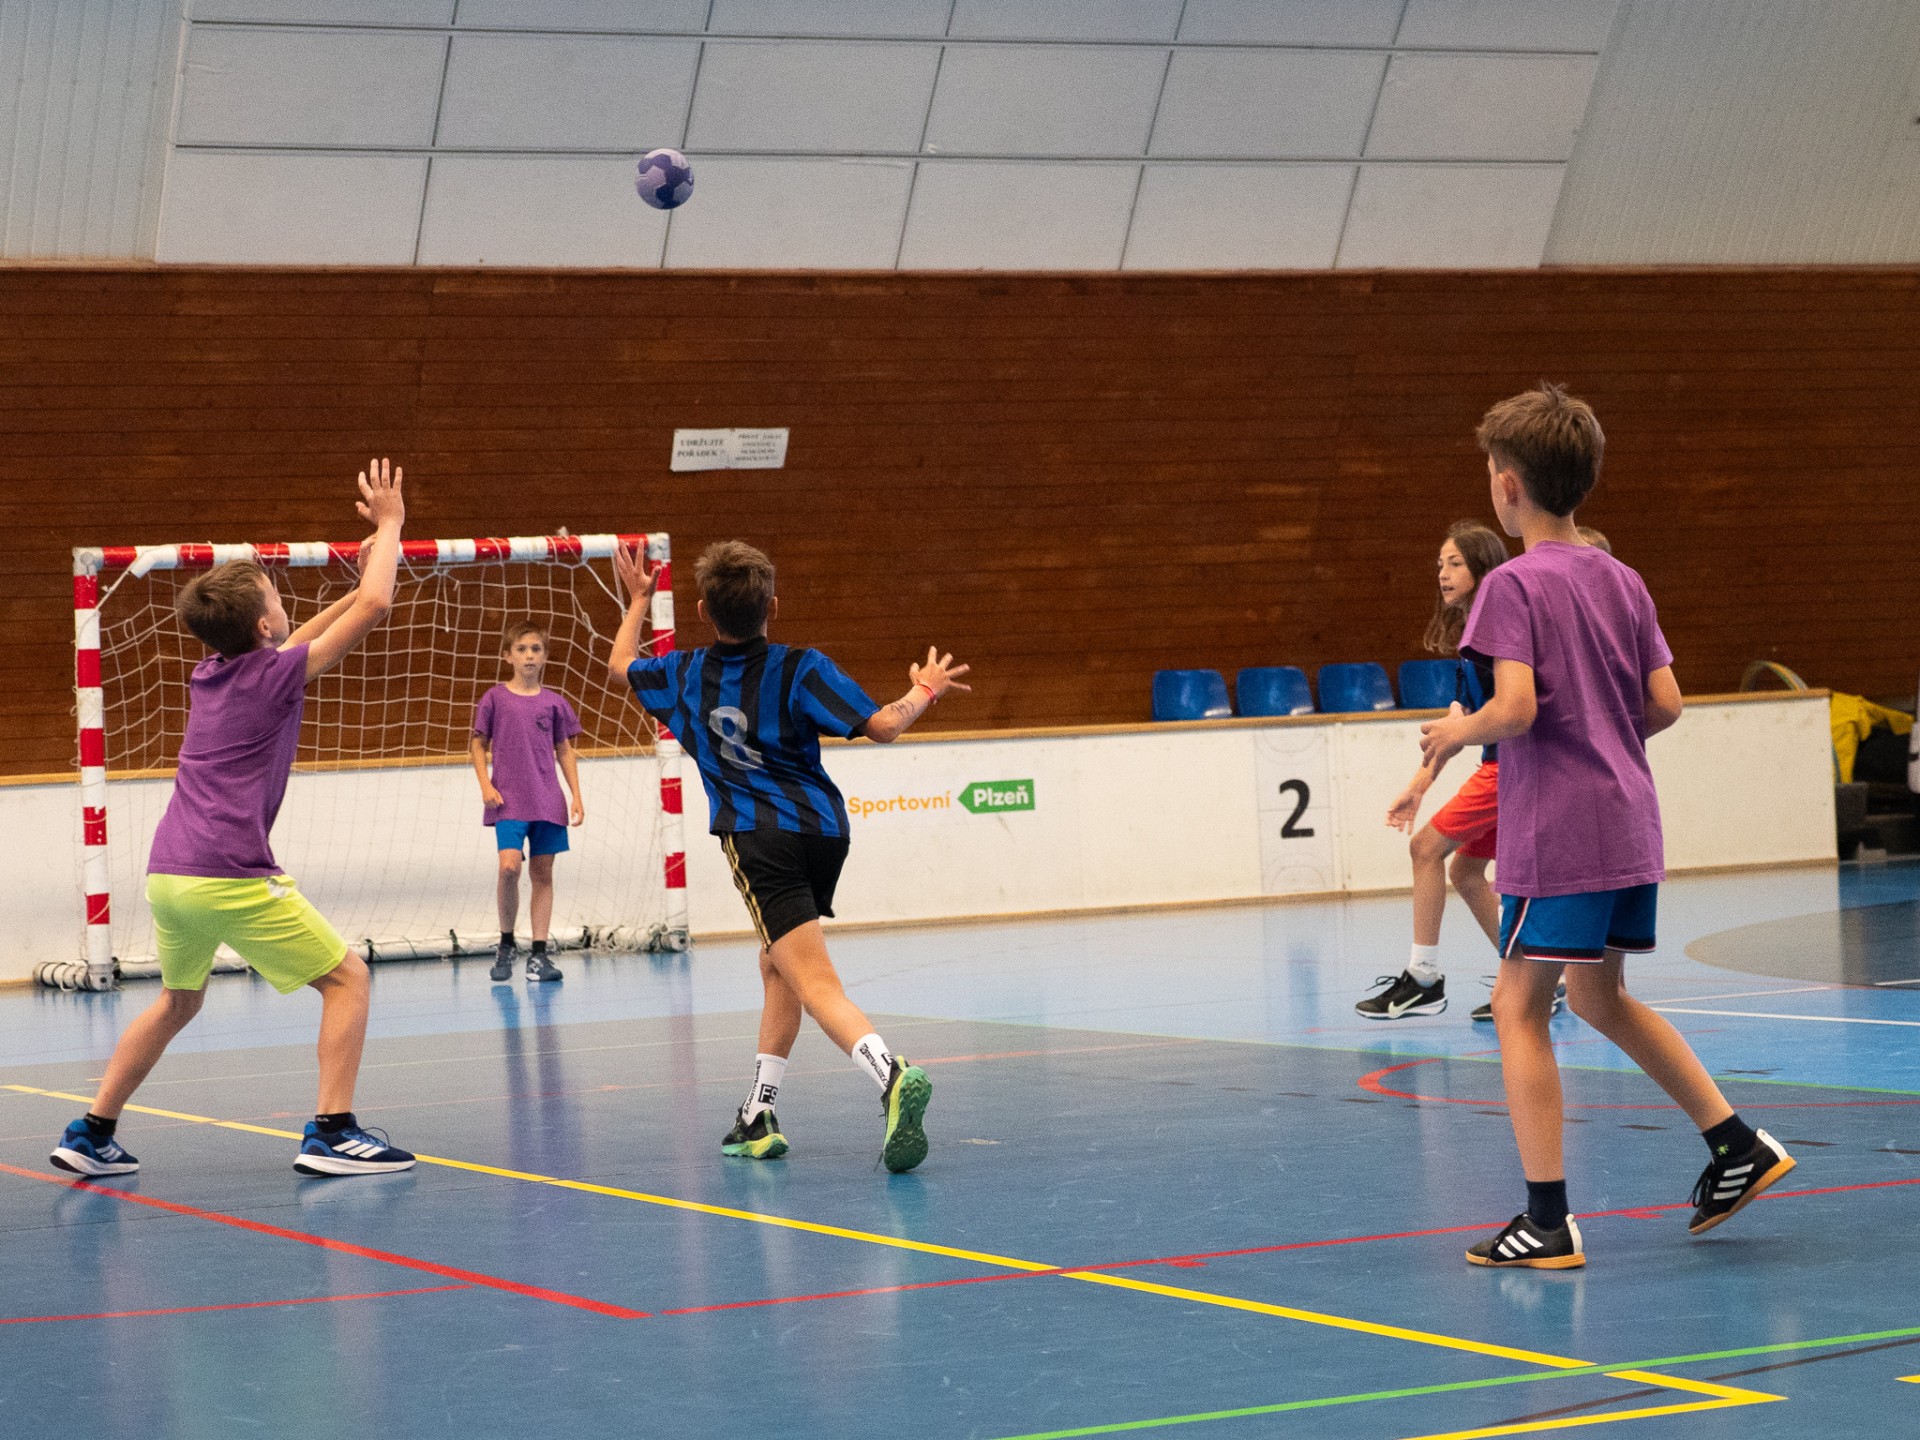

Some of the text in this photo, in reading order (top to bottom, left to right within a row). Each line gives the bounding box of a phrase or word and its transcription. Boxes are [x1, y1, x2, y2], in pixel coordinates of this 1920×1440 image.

[709, 706, 763, 770] 8
[848, 785, 1029, 818] Sportovní Plzeň
[1279, 779, 1314, 838] 2
